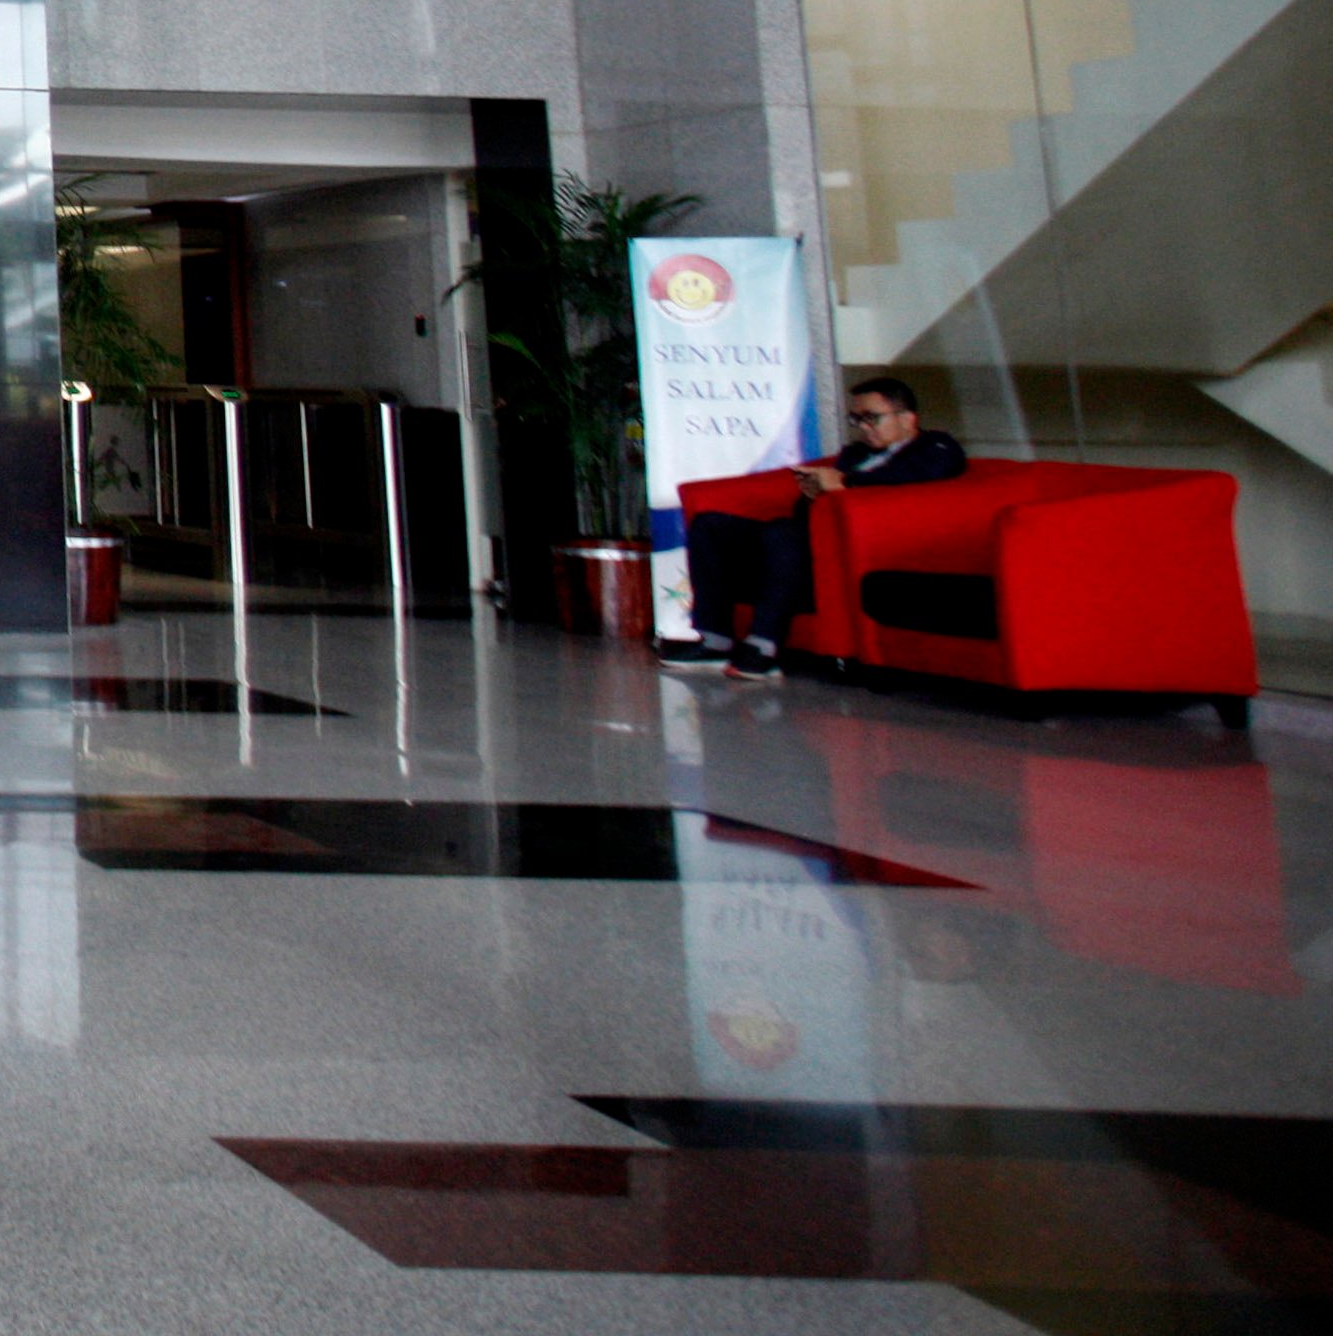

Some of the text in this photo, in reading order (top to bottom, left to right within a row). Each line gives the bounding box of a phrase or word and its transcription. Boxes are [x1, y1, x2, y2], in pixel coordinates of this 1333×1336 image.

[653, 343, 782, 366] SENYUM
[667, 379, 774, 402] SALAM
[685, 415, 762, 438] SAPA
